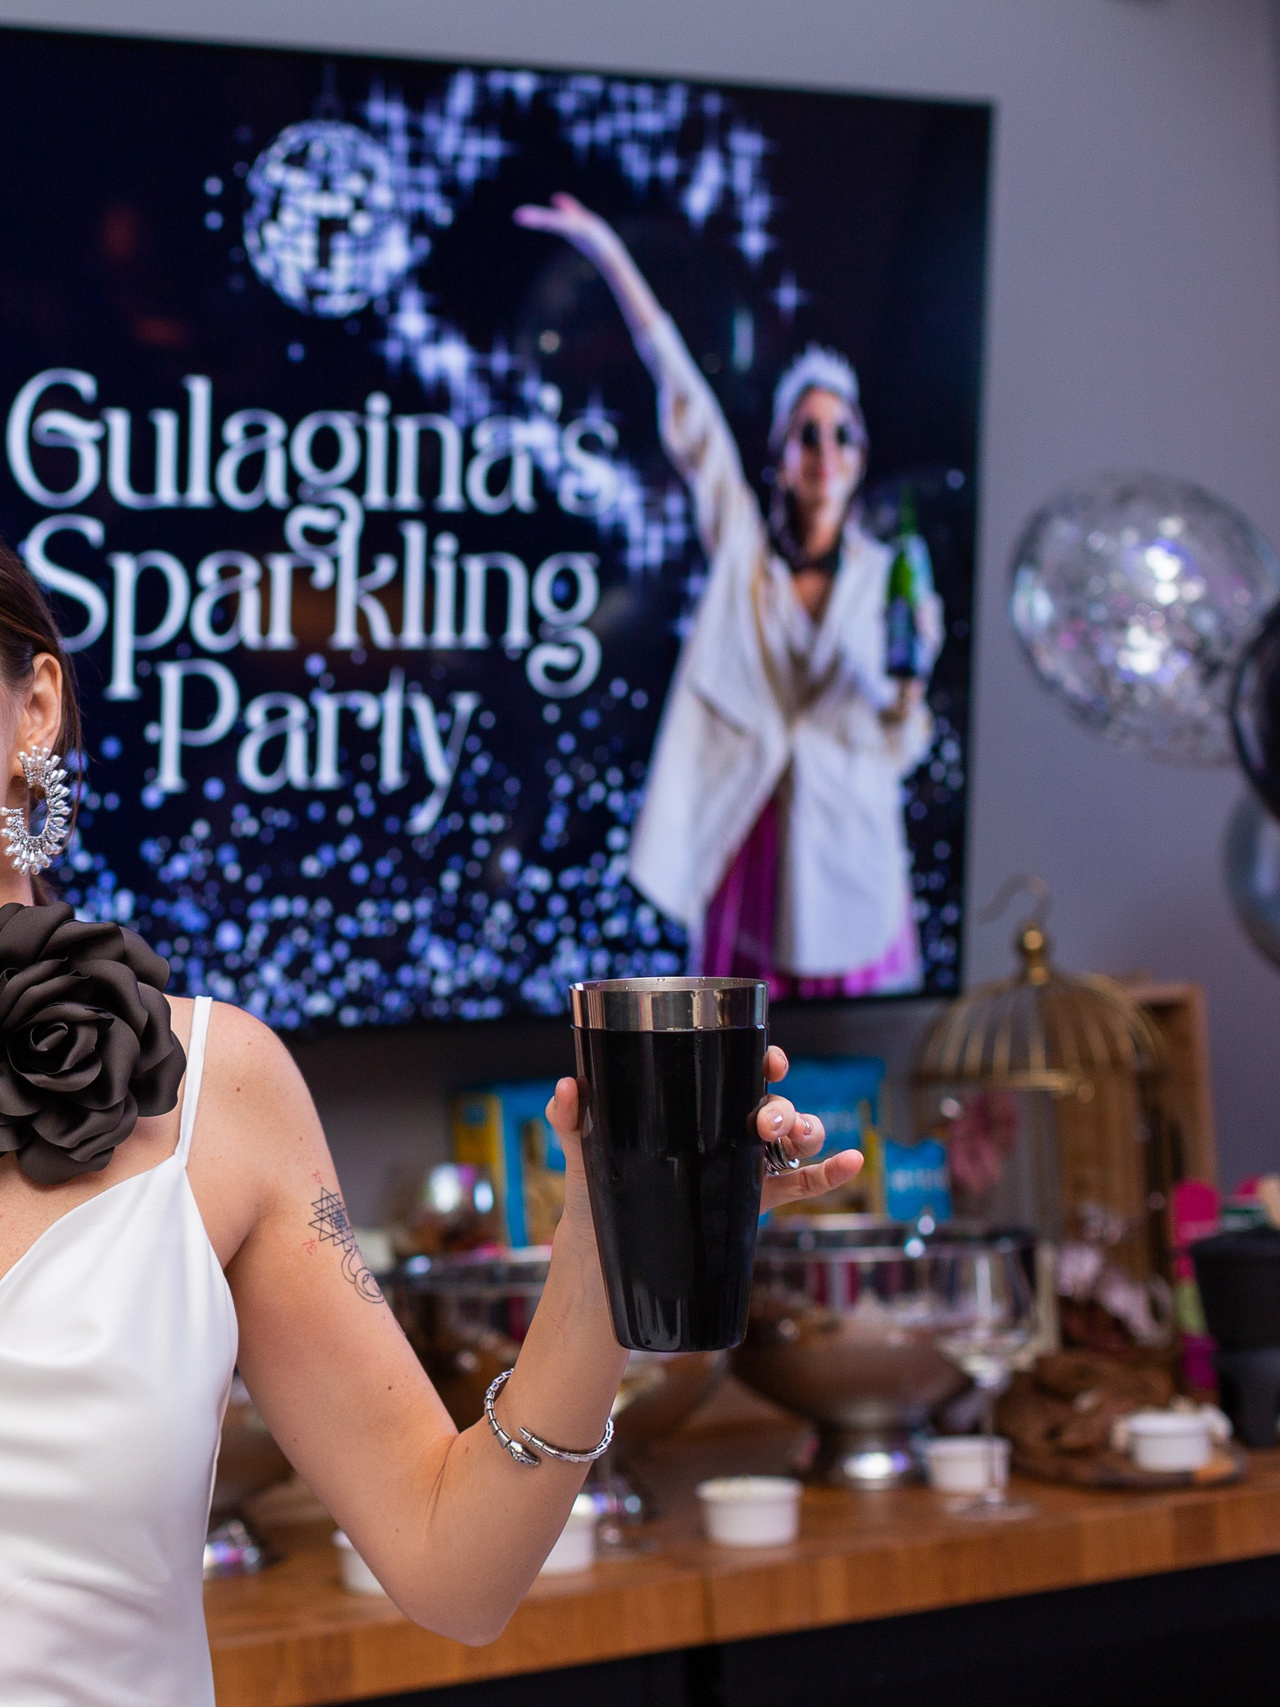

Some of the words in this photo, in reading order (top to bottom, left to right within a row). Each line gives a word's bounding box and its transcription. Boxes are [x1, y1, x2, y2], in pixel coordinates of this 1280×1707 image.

[6, 367, 620, 557] Gulagina's
[24, 513, 602, 700] Sparkling
[153, 658, 479, 834] Party
